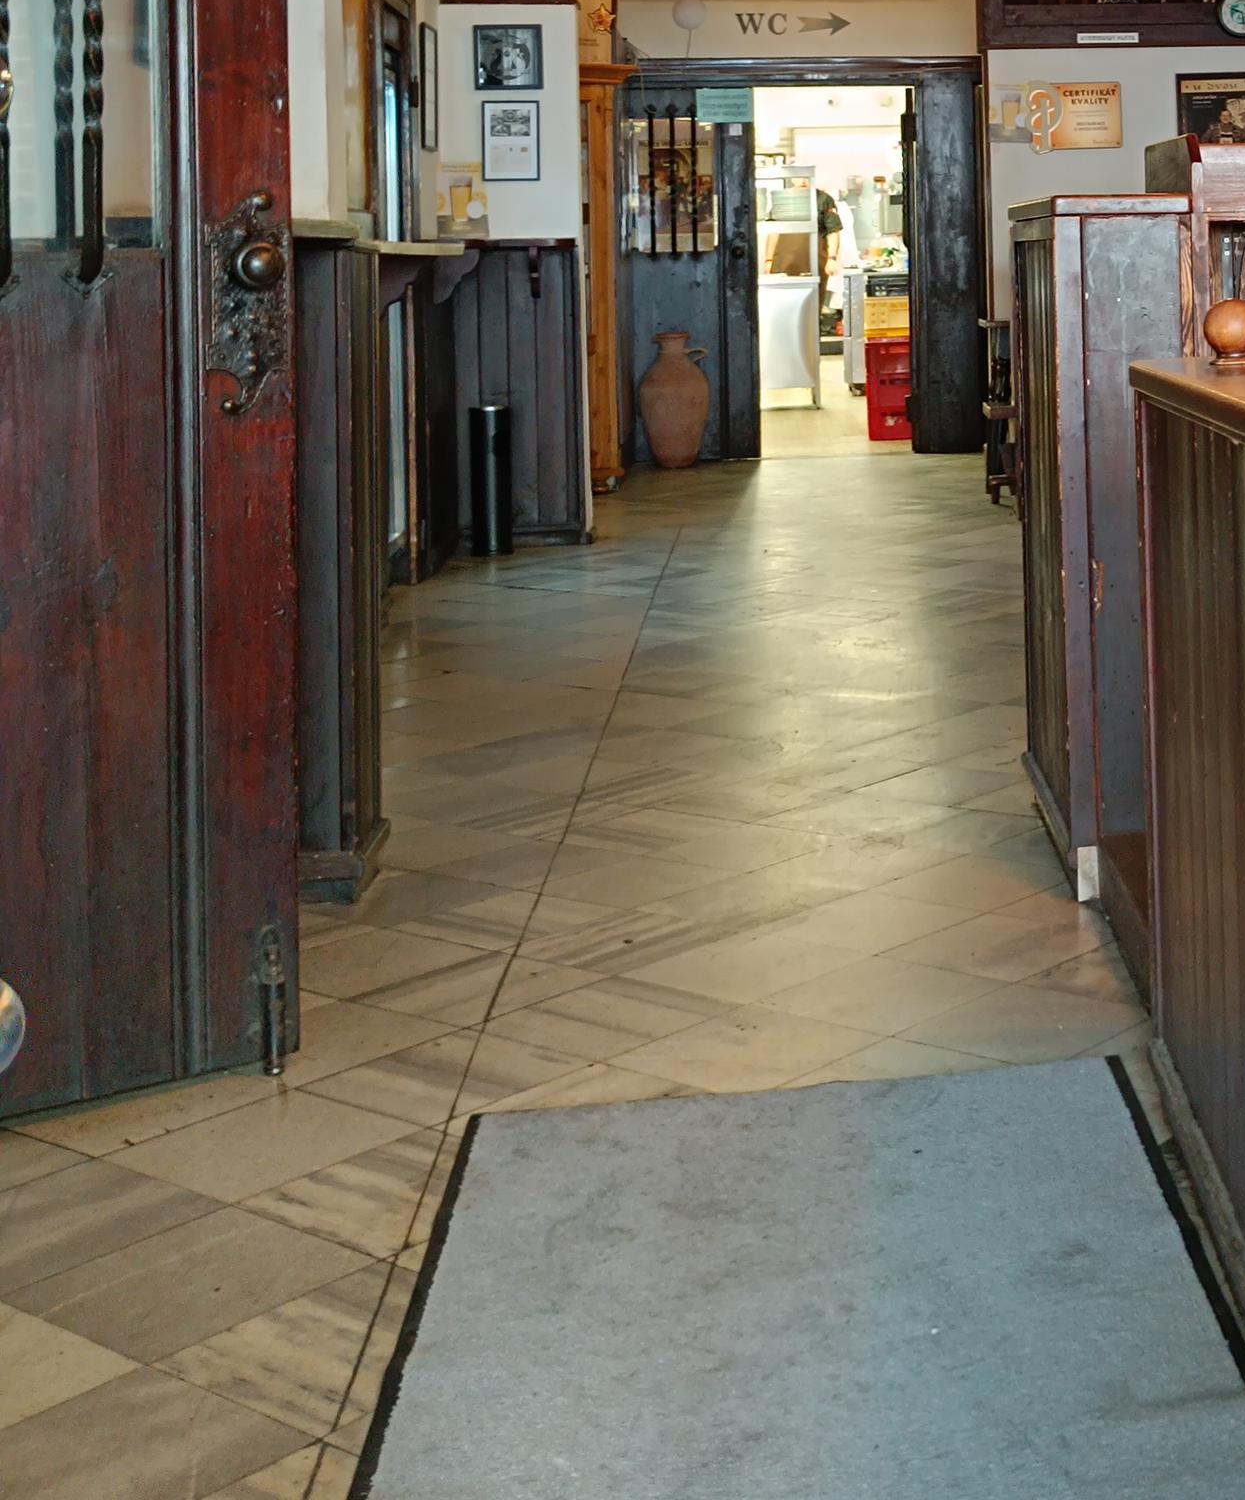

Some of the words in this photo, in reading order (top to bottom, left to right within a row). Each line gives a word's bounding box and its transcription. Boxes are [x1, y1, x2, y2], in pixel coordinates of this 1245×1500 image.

[735, 13, 788, 36] WC
[1063, 88, 1117, 98] CERTIFIKÁT
[1071, 97, 1110, 106] KVALITY
